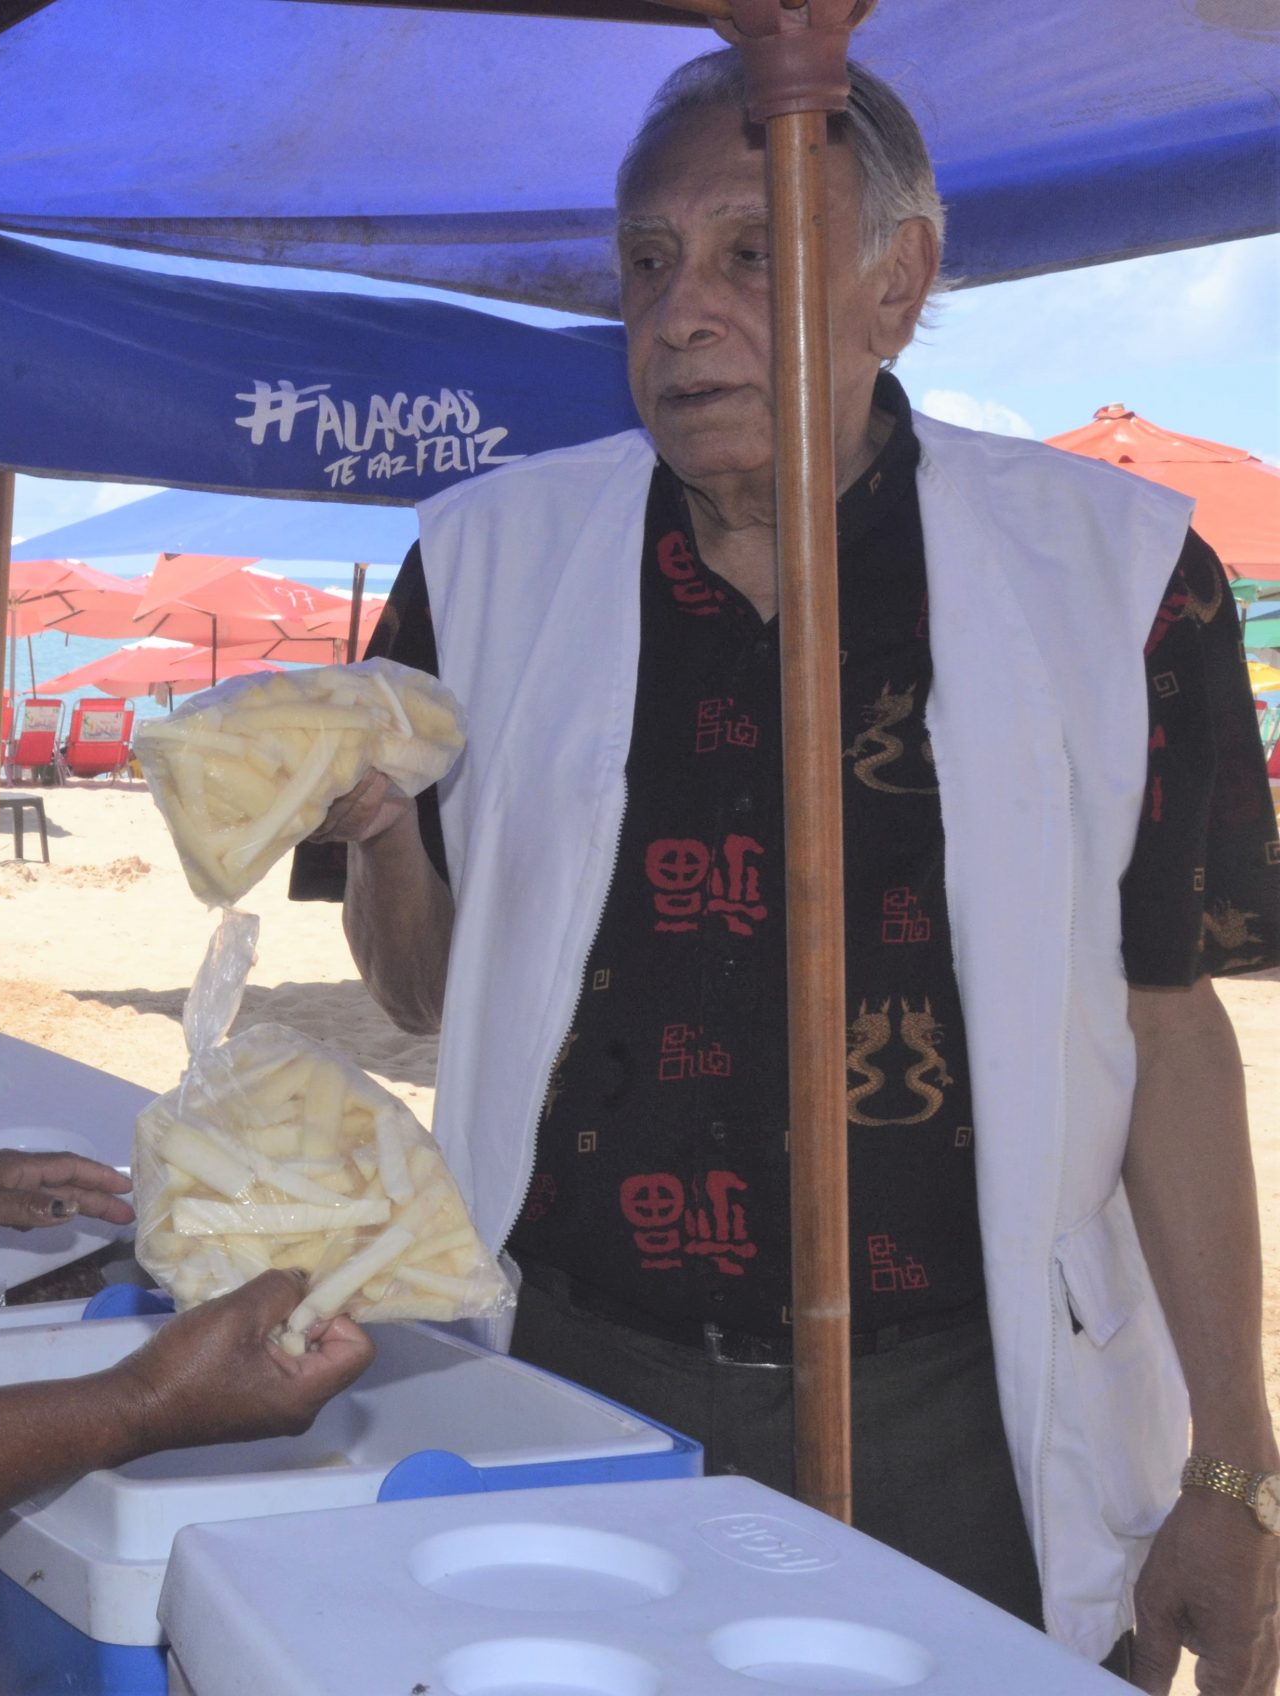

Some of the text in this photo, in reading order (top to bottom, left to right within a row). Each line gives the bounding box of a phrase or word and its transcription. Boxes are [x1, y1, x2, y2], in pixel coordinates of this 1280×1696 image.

[235, 379, 481, 455] #ALAGOAS
[323, 427, 528, 488] TE FAZ FELIZ
